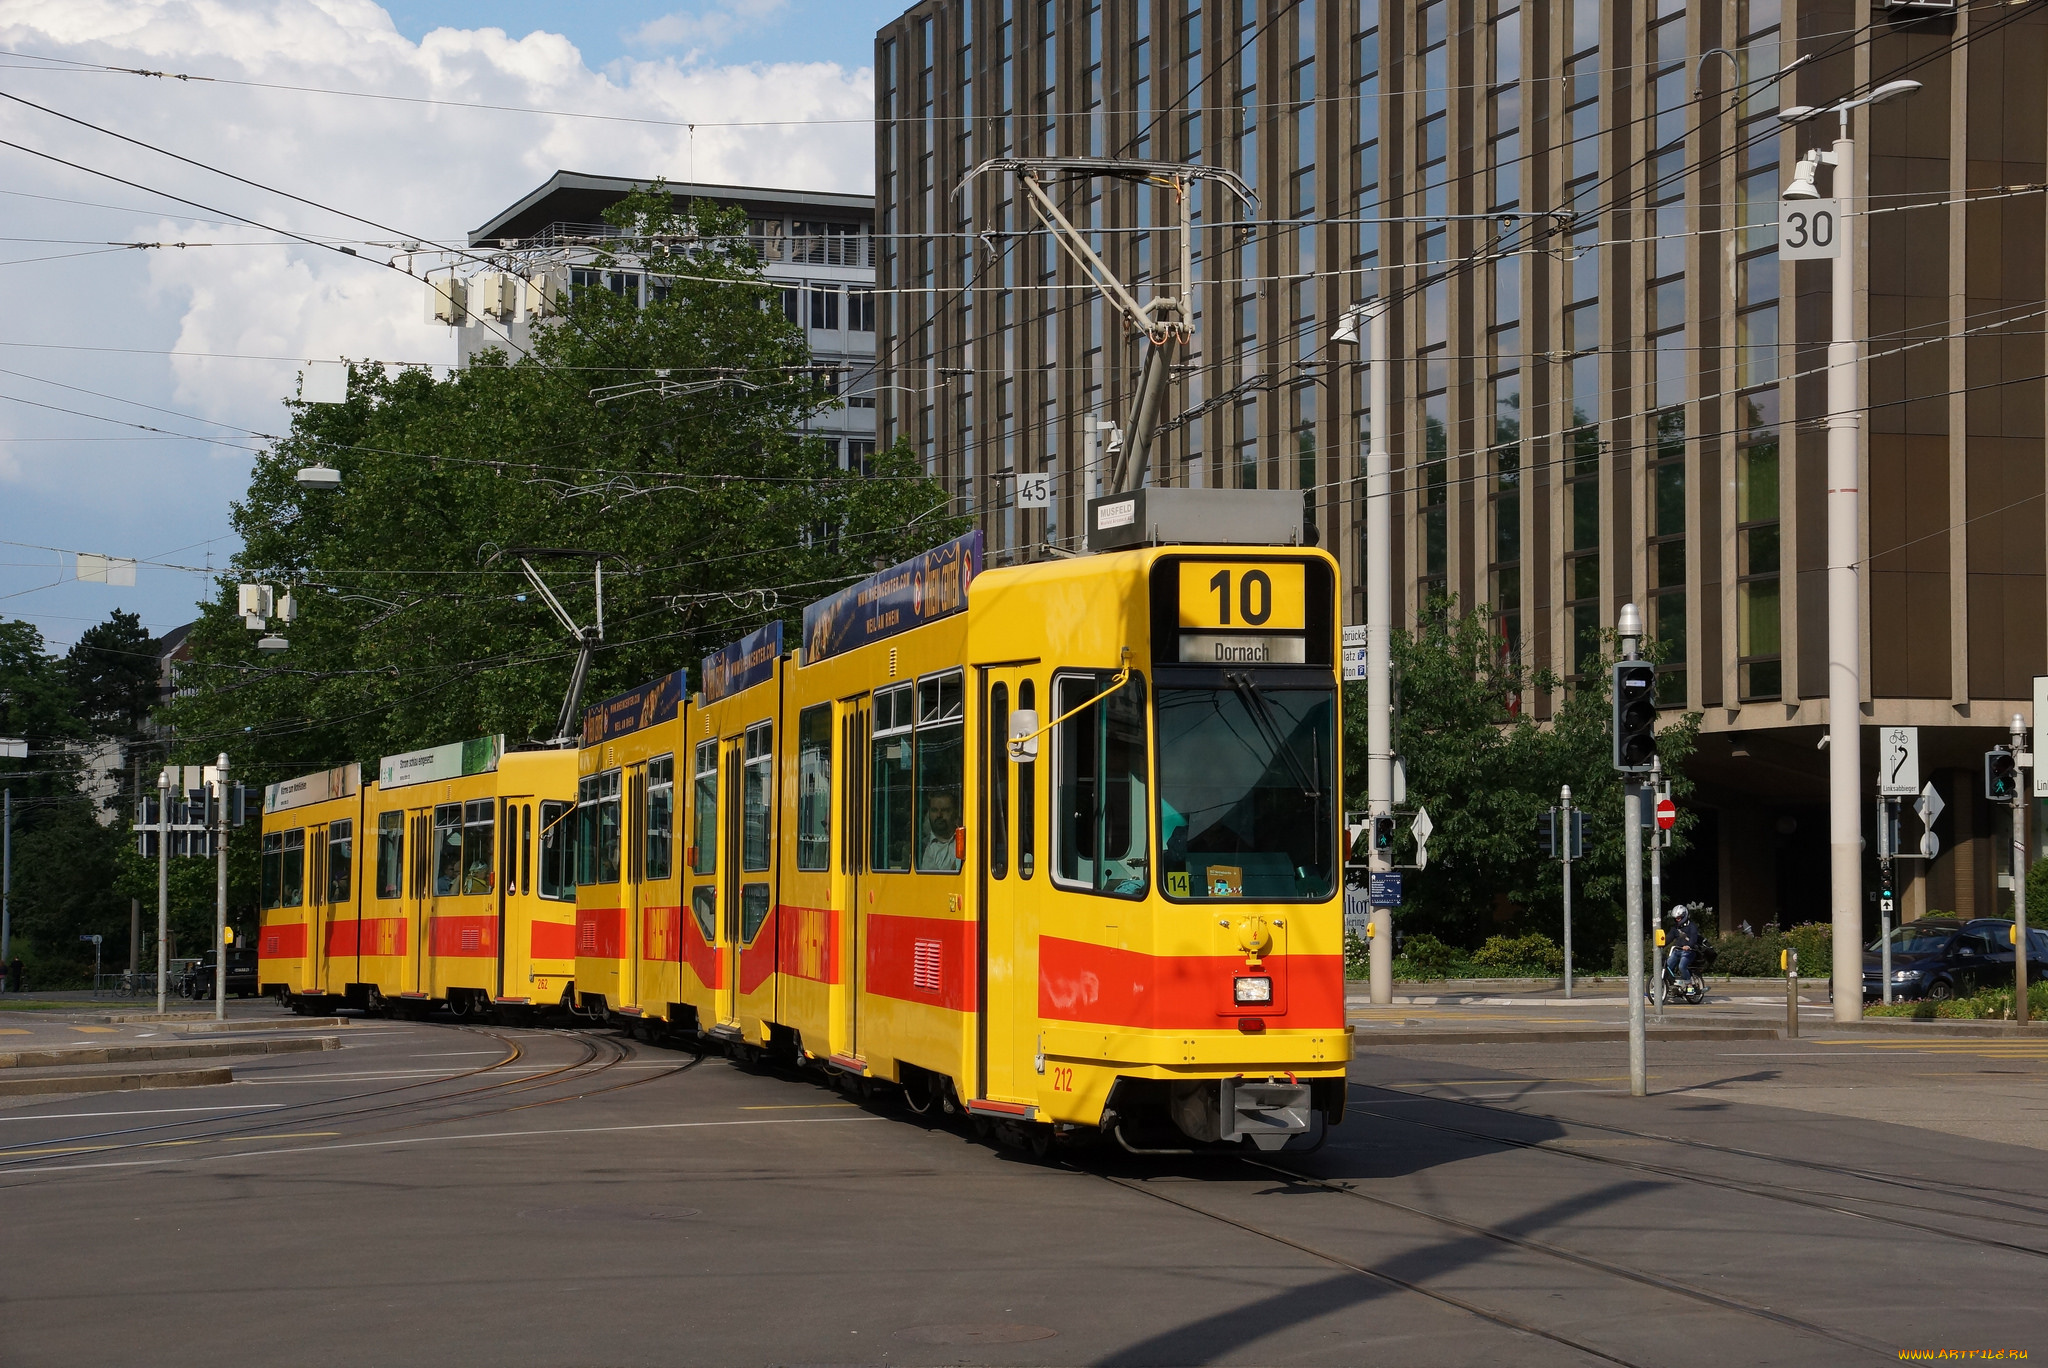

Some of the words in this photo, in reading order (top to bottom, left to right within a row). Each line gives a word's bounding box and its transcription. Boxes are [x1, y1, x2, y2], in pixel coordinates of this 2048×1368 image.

[1785, 211, 1833, 248] 30
[1022, 480, 1046, 501] 45
[1100, 504, 1132, 518] MUSFELD
[1210, 569, 1272, 626] 10
[1343, 630, 1366, 642] brücke
[1215, 643, 1270, 661] Dornach
[1883, 785, 1917, 793] Linksabbieger
[2036, 780, 2048, 791] Lin
[1170, 875, 1187, 892] 14
[538, 979, 548, 990] 262
[1054, 1067, 1073, 1092] 212
